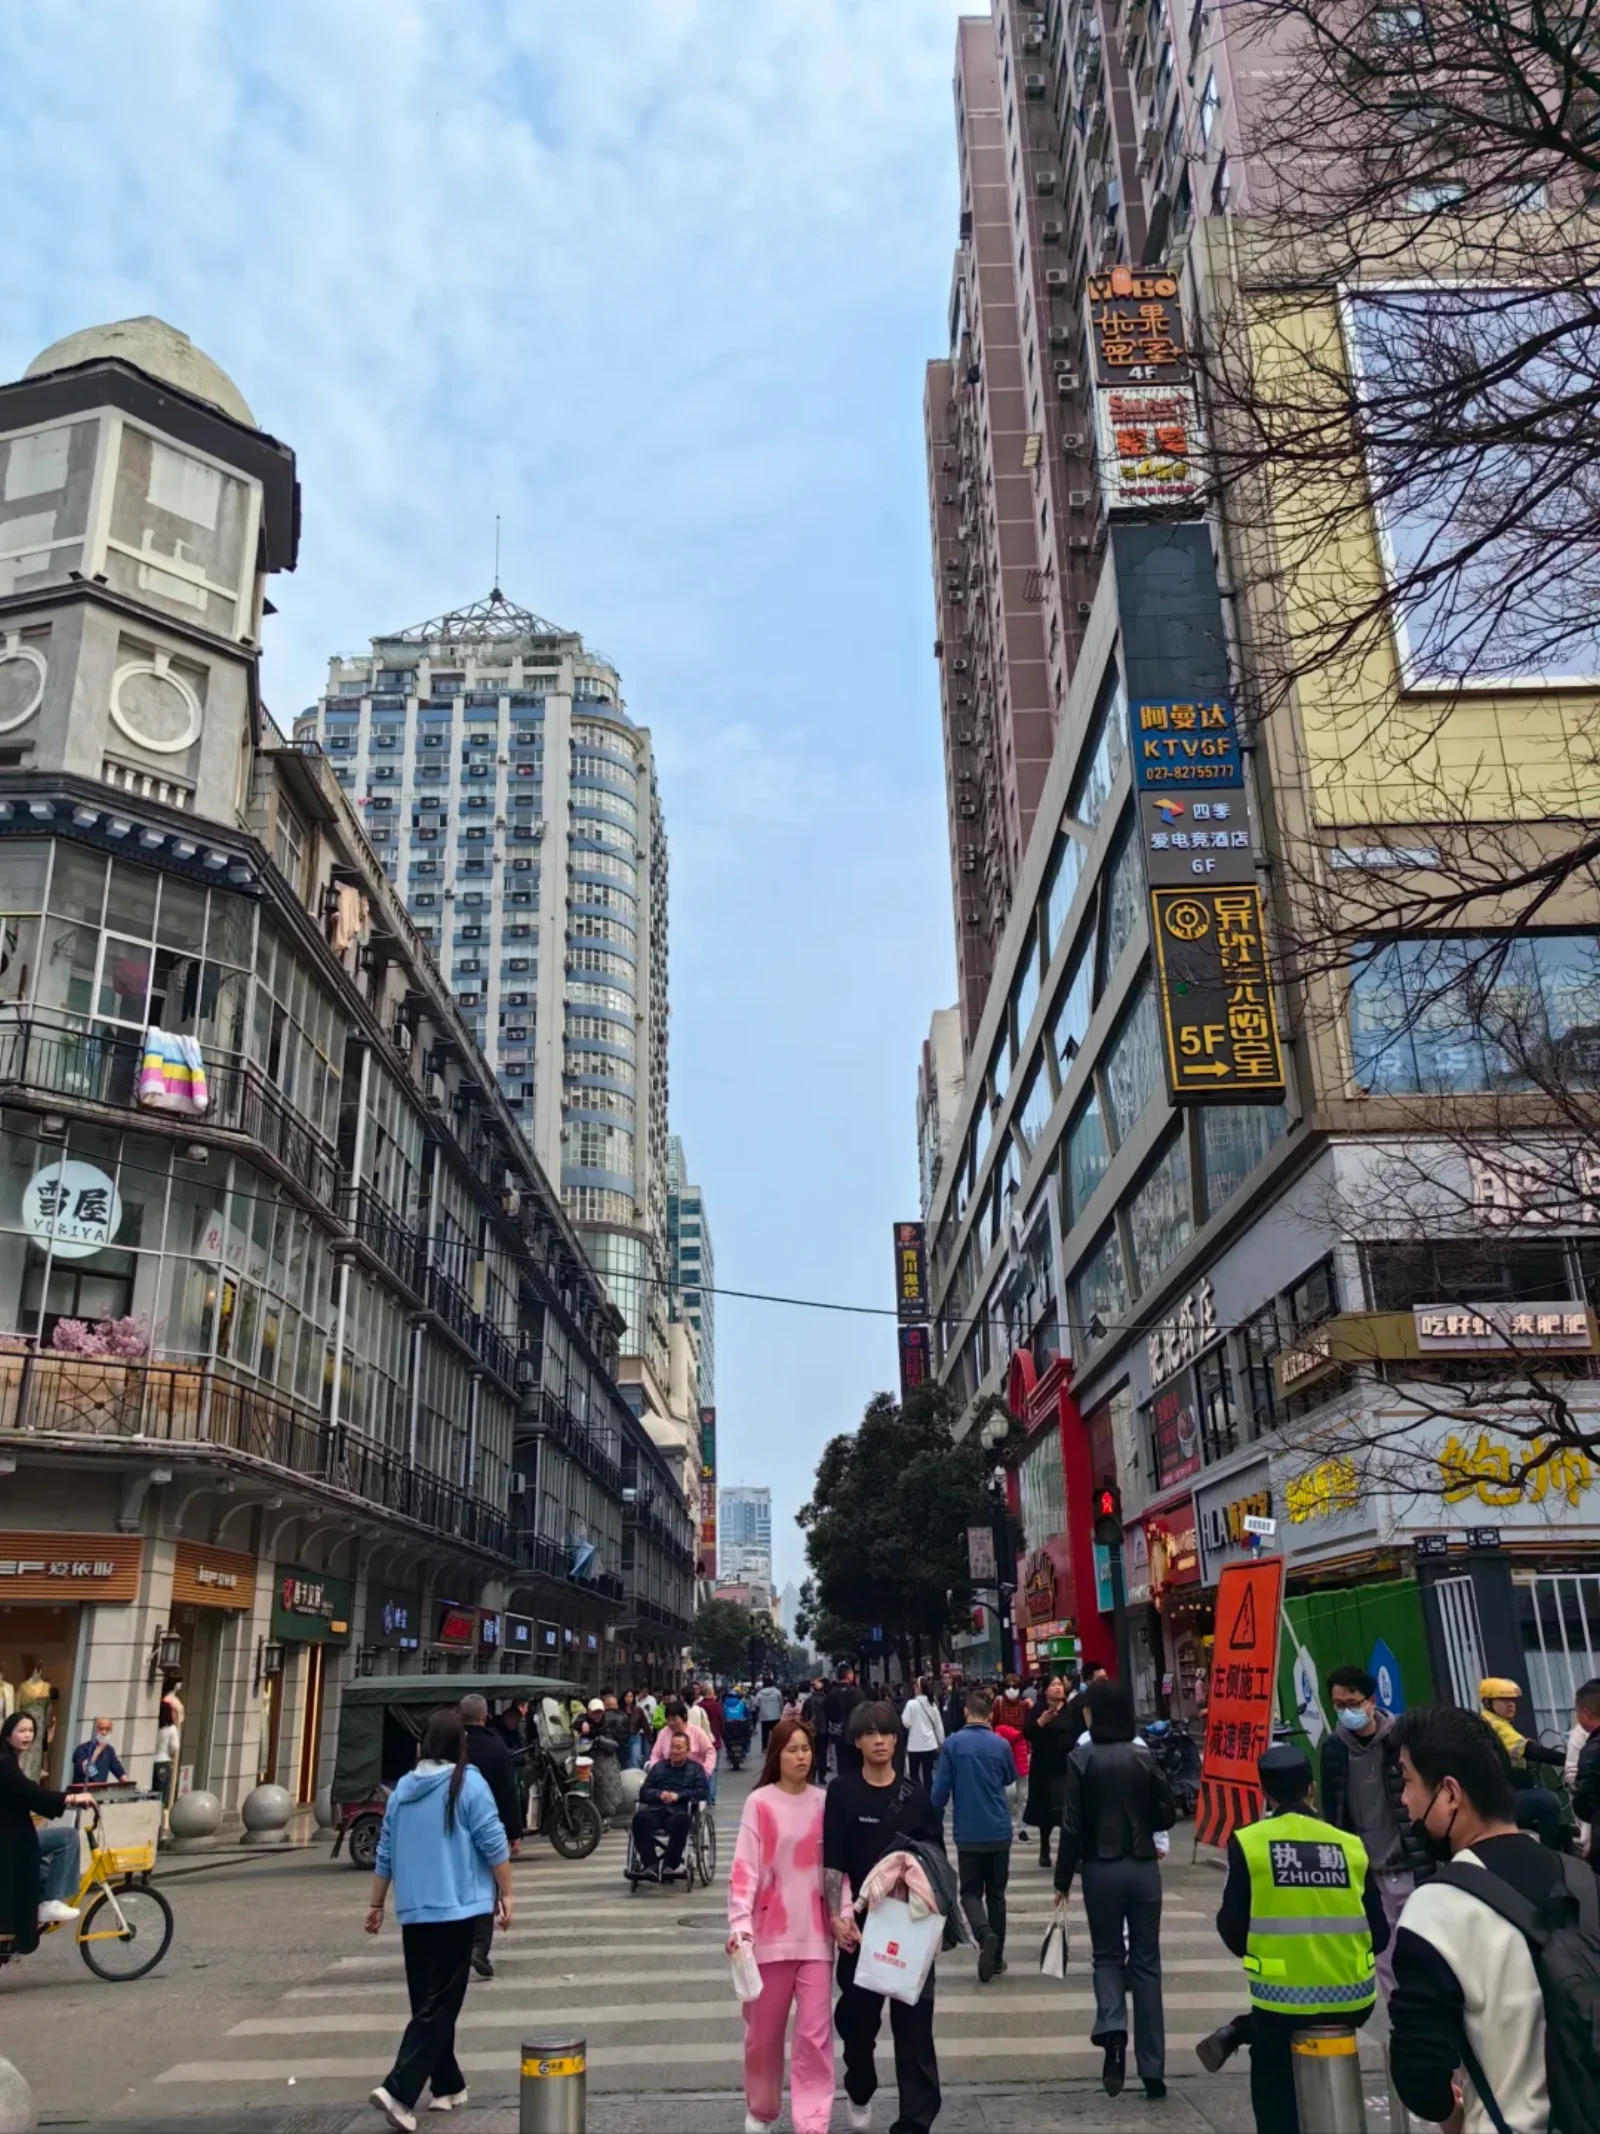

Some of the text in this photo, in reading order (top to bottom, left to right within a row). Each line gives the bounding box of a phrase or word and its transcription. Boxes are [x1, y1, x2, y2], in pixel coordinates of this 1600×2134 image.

[1129, 365, 1157, 379] 4F
[1140, 703, 1228, 729] 阿曼达
[1193, 803, 1231, 819] 四季
[1151, 831, 1249, 849] 爱电竞酒店
[1192, 858, 1216, 873] 6F
[1214, 896, 1275, 1077] 异次元密室
[1180, 1025, 1225, 1055] 5F
[37, 1180, 108, 1225] 雪屋
[1421, 1313, 1587, 1336] 吃好虾 来肥肥
[1201, 1507, 1228, 1551] HLA
[48, 1561, 114, 1576] 爱依服
[1213, 1662, 1269, 1699] 左侧施工
[1210, 1719, 1268, 1762] 减速慢行
[1278, 1871, 1346, 1884] ZHIQIN
